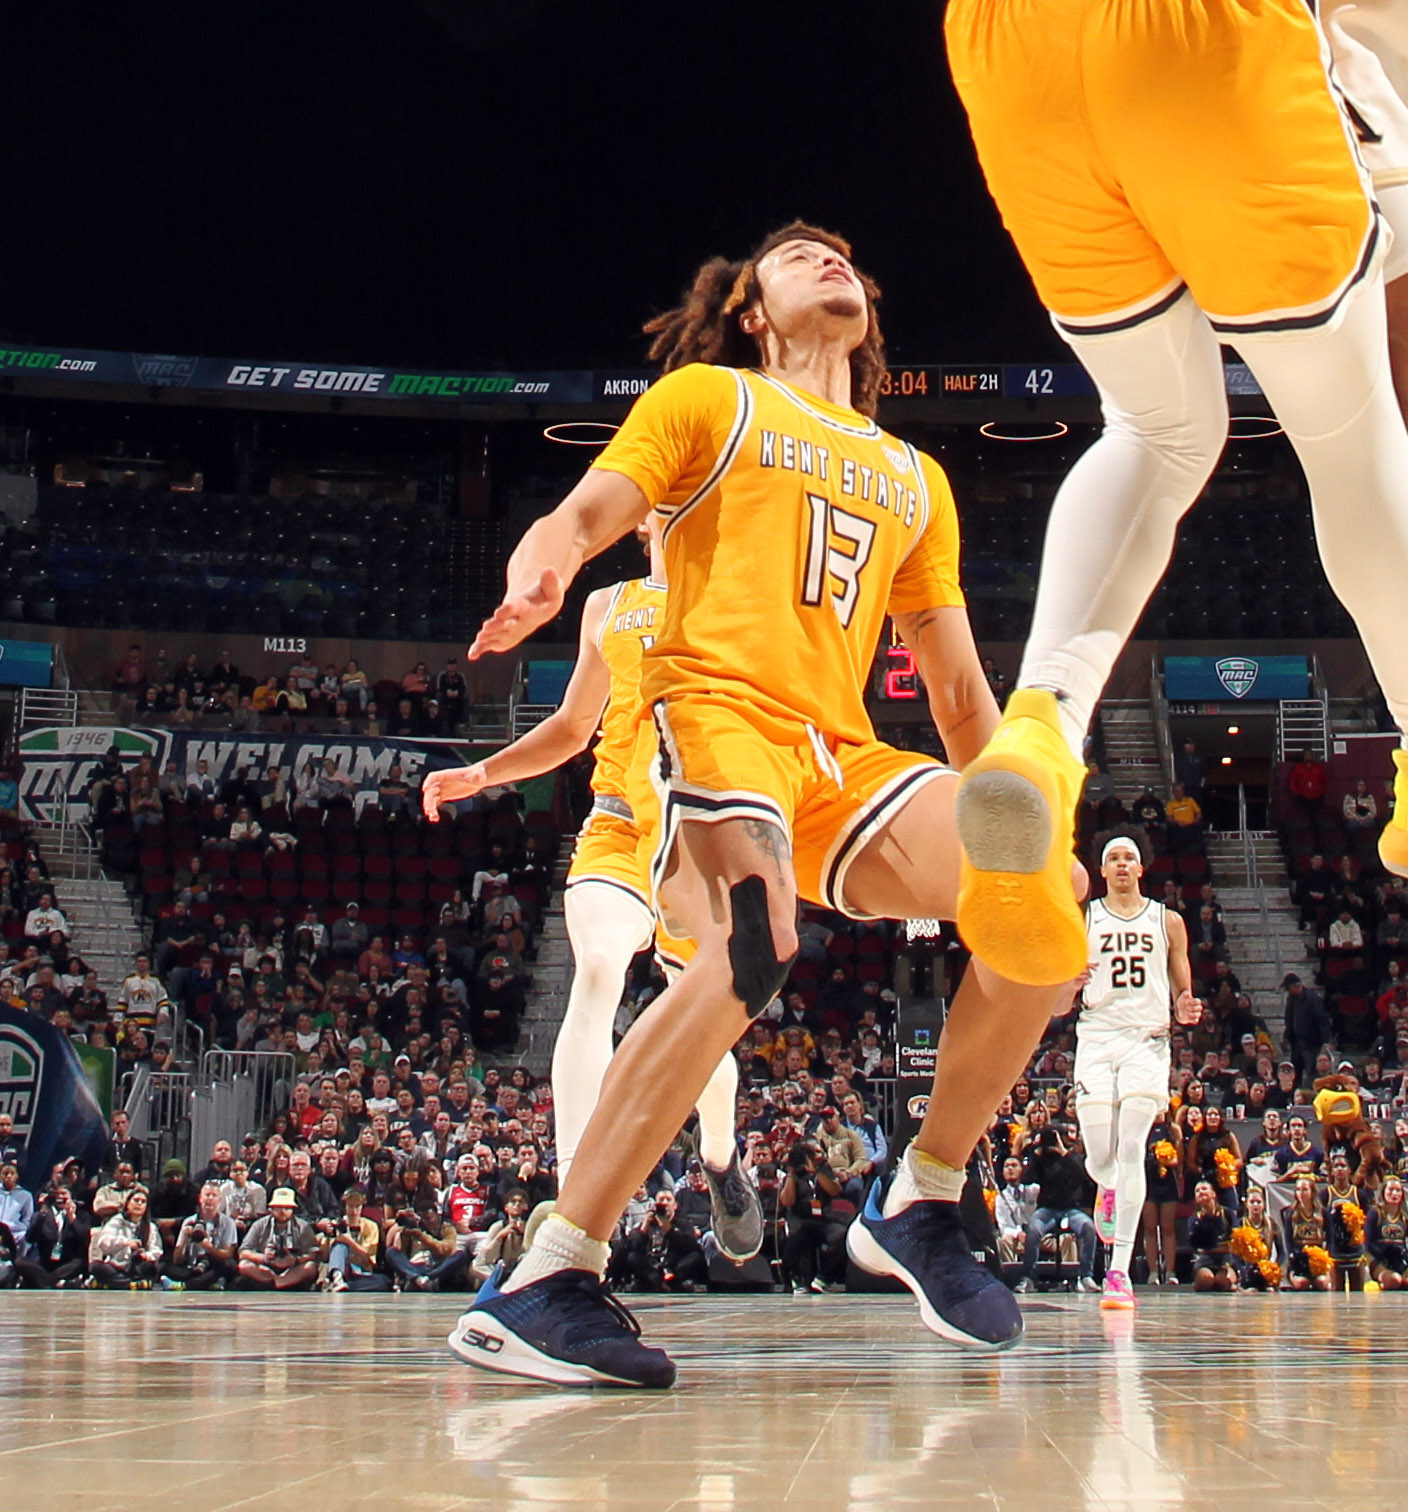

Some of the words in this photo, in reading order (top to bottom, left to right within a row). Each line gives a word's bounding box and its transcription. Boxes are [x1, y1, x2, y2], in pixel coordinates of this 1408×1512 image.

[227, 366, 290, 387] GET
[293, 369, 385, 393] SOME
[603, 379, 649, 395] AKRON
[944, 374, 978, 391] HALF
[979, 373, 999, 391] 2H
[1025, 369, 1054, 394] 42
[760, 430, 829, 479] KENT
[841, 460, 918, 528] STATE
[801, 492, 877, 630] 13
[613, 607, 655, 633] KENT
[263, 637, 306, 653] M113
[1221, 670, 1254, 681] MAC
[65, 732, 108, 748] 1946
[185, 739, 429, 788] WELCOME
[1100, 932, 1154, 953] ZIPS
[1111, 956, 1146, 988] 25
[910, 1058, 934, 1066] Clinic
[463, 1206, 473, 1219] 3
